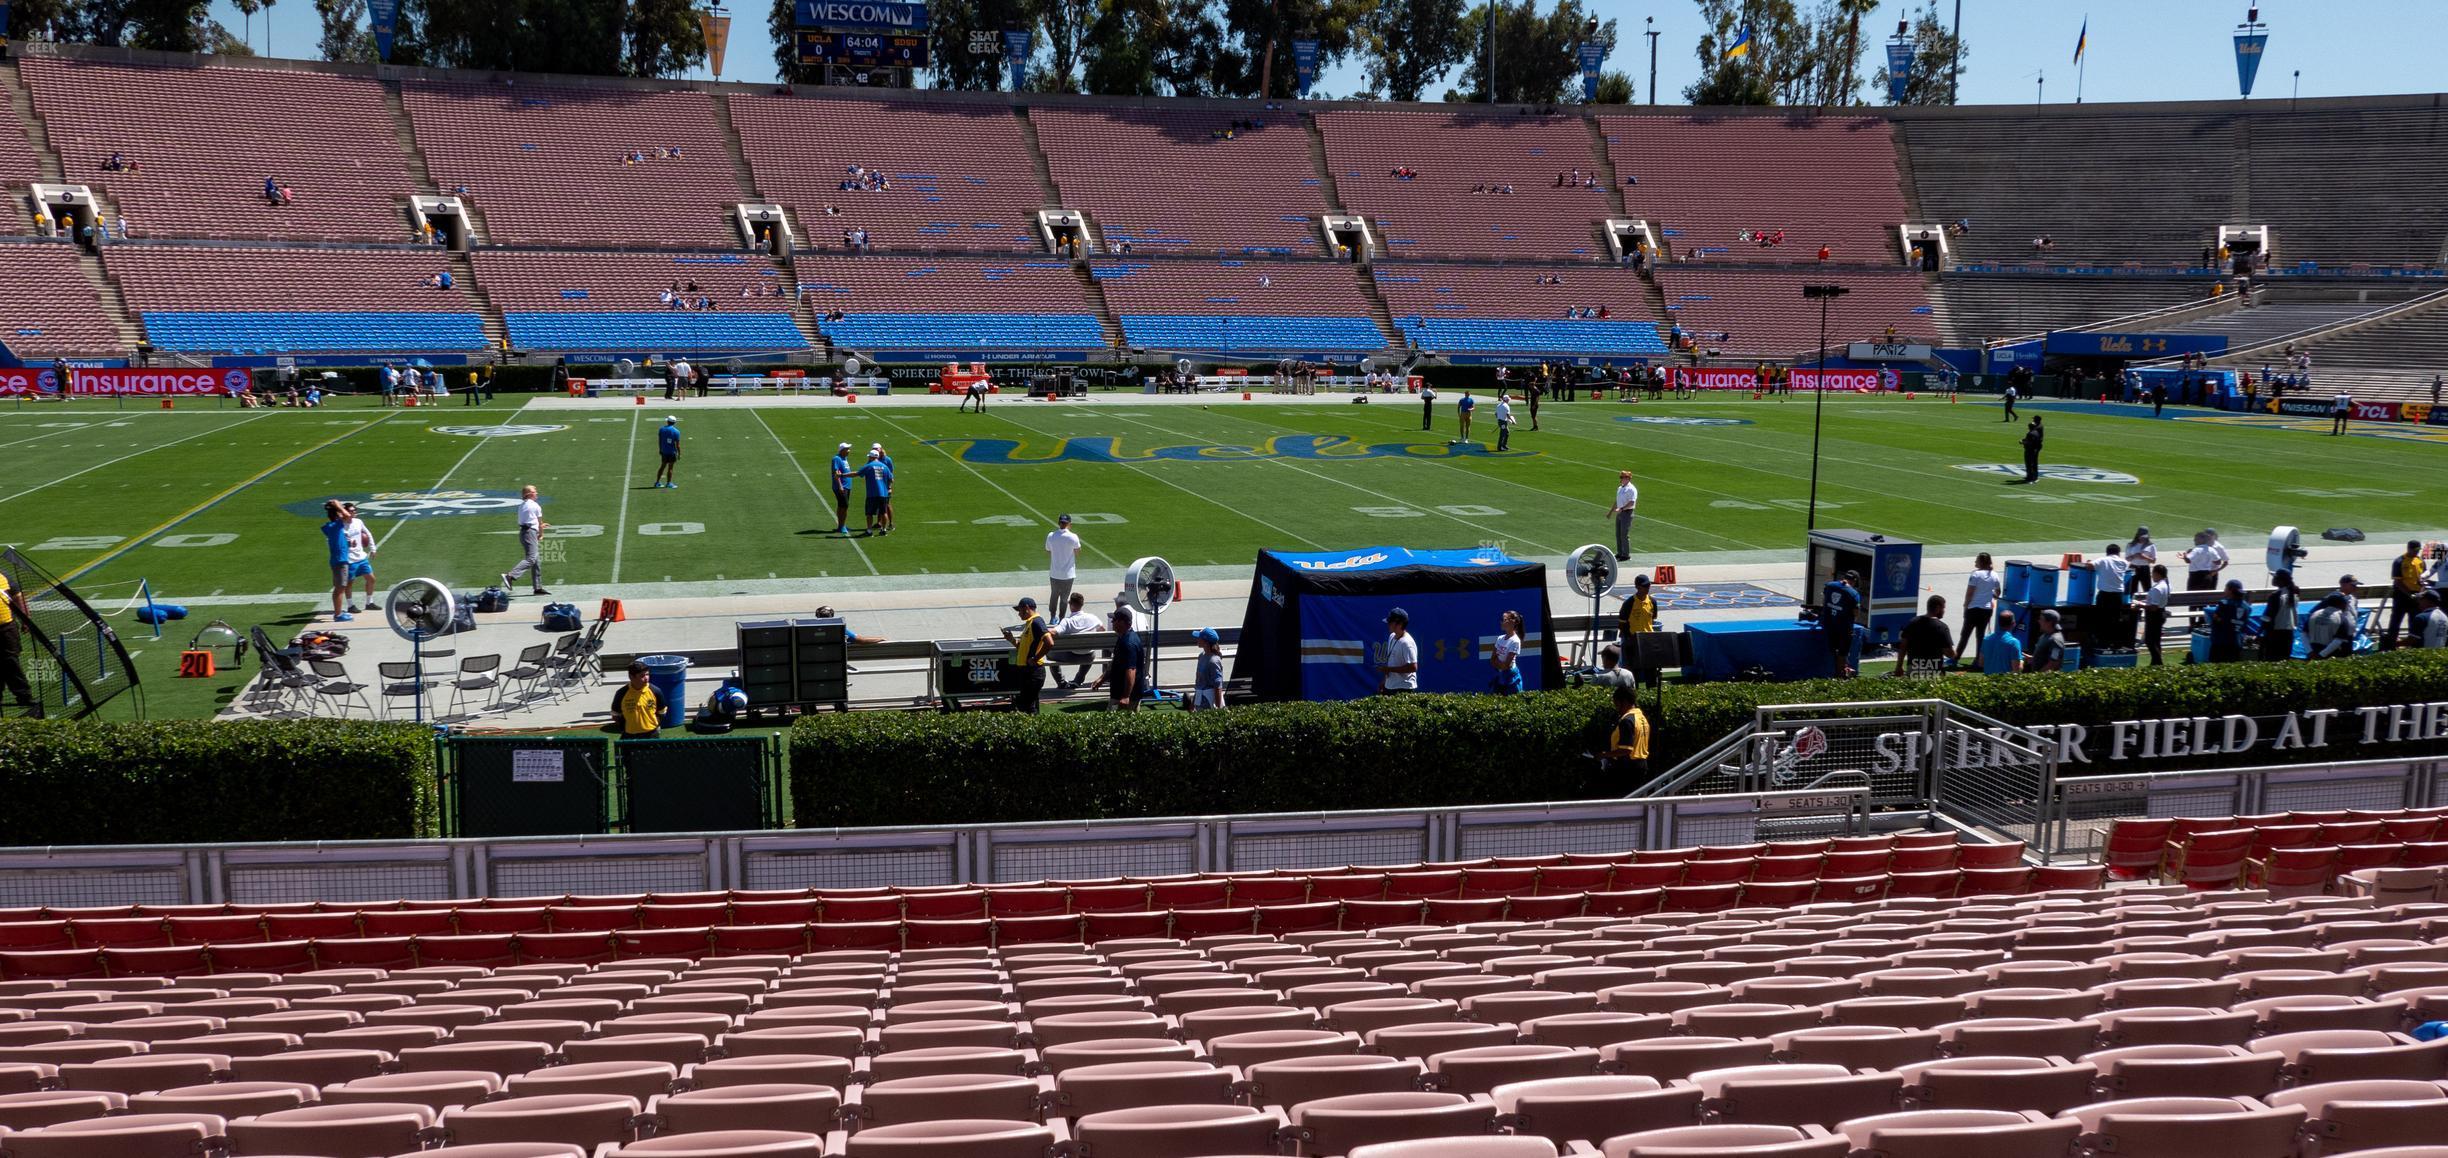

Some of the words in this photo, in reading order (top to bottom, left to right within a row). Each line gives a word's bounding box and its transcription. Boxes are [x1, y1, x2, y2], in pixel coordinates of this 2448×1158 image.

[809, 2, 890, 22] WESCOM
[807, 34, 832, 43] UCLA
[847, 37, 879, 48] 64:04
[894, 38, 918, 46] SDSU
[815, 44, 822, 55] 0
[903, 49, 910, 59] 0
[856, 73, 868, 83] 42
[2100, 336, 2133, 352] Ucla
[892, 368, 941, 378] SPIEKER
[1008, 368, 1035, 378] THE
[1791, 370, 1877, 388] Insurance
[73, 370, 215, 393] Insurance
[572, 382, 581, 390] G
[2285, 403, 2326, 413] NISSAN
[2358, 405, 2390, 418] TCL
[912, 434, 1550, 464] Ucla
[1351, 503, 1507, 518] 50
[970, 512, 1130, 527] 40
[540, 522, 706, 538] 30
[27, 533, 241, 551] 20
[1293, 552, 1389, 569] Ucla
[1659, 565, 1675, 583] 50
[601, 600, 618, 620] 30
[182, 653, 209, 677] 20
[2110, 714, 2259, 761] FIELD
[2274, 708, 2339, 750] AT
[2355, 701, 2448, 744] THE
[2066, 783, 2100, 795] SEATS
[2103, 781, 2134, 793] 101-130
[1789, 798, 1825, 808] SEATS
[1827, 797, 1847, 807] 1-30
